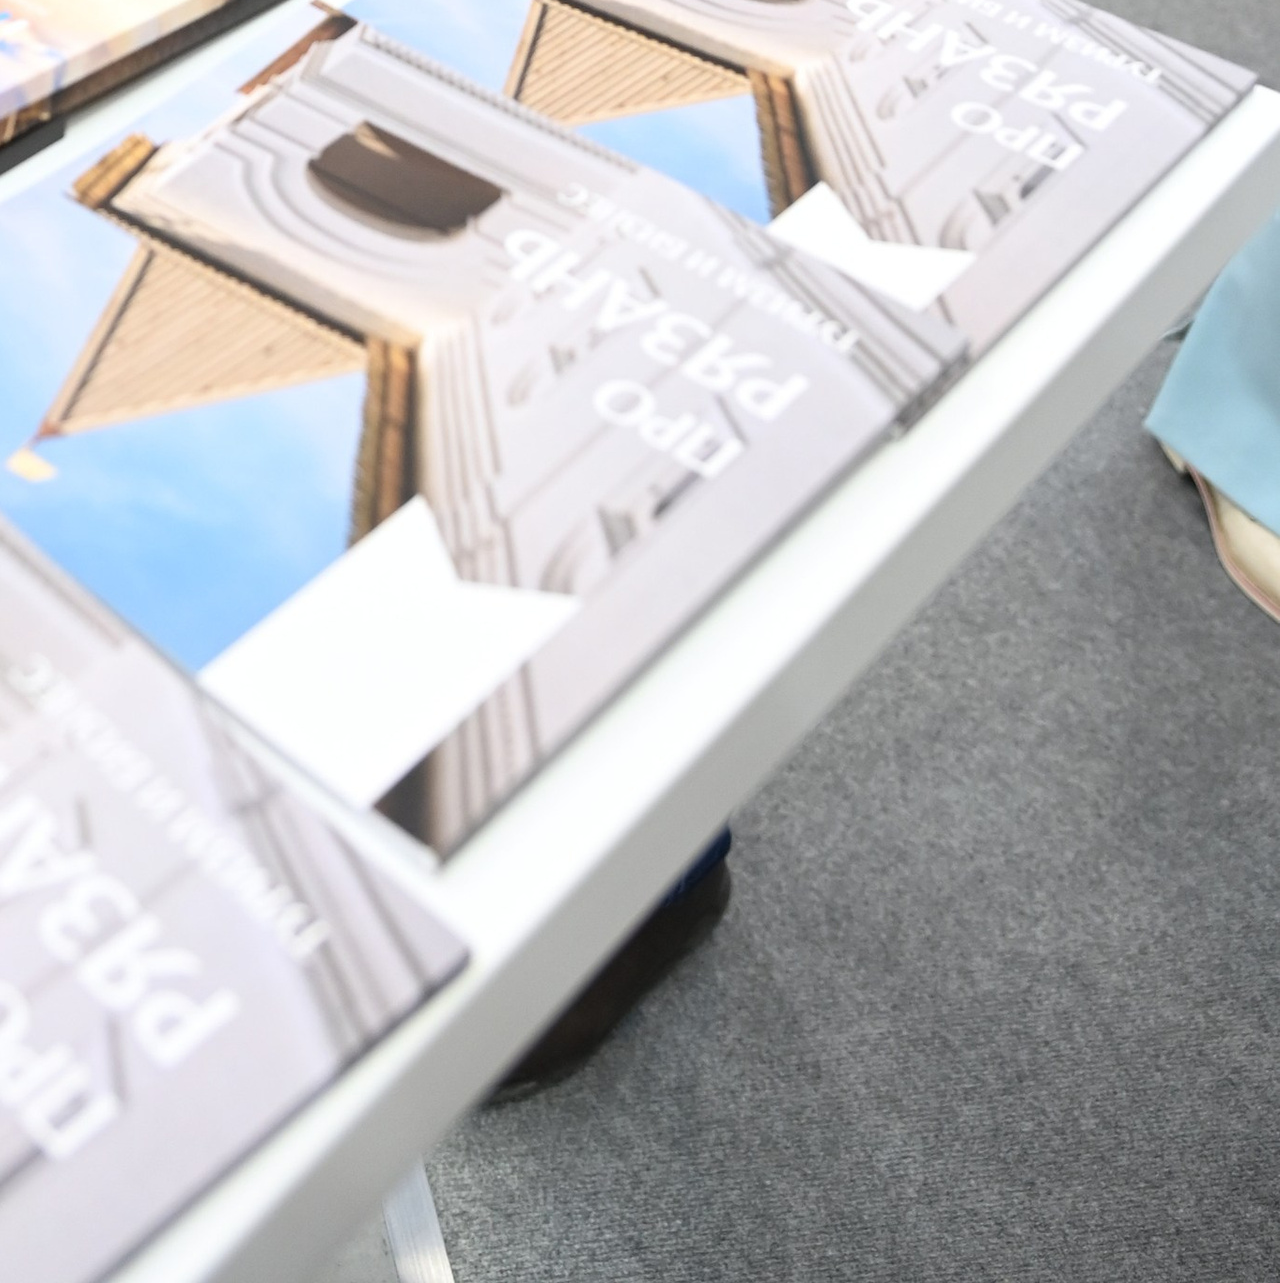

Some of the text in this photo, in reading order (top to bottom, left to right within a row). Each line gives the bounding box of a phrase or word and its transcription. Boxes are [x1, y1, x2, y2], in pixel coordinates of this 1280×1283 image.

[950, 98, 1086, 174] ПРО
[503, 228, 811, 424] РЯЗАНЬ
[598, 373, 745, 483] ПРО
